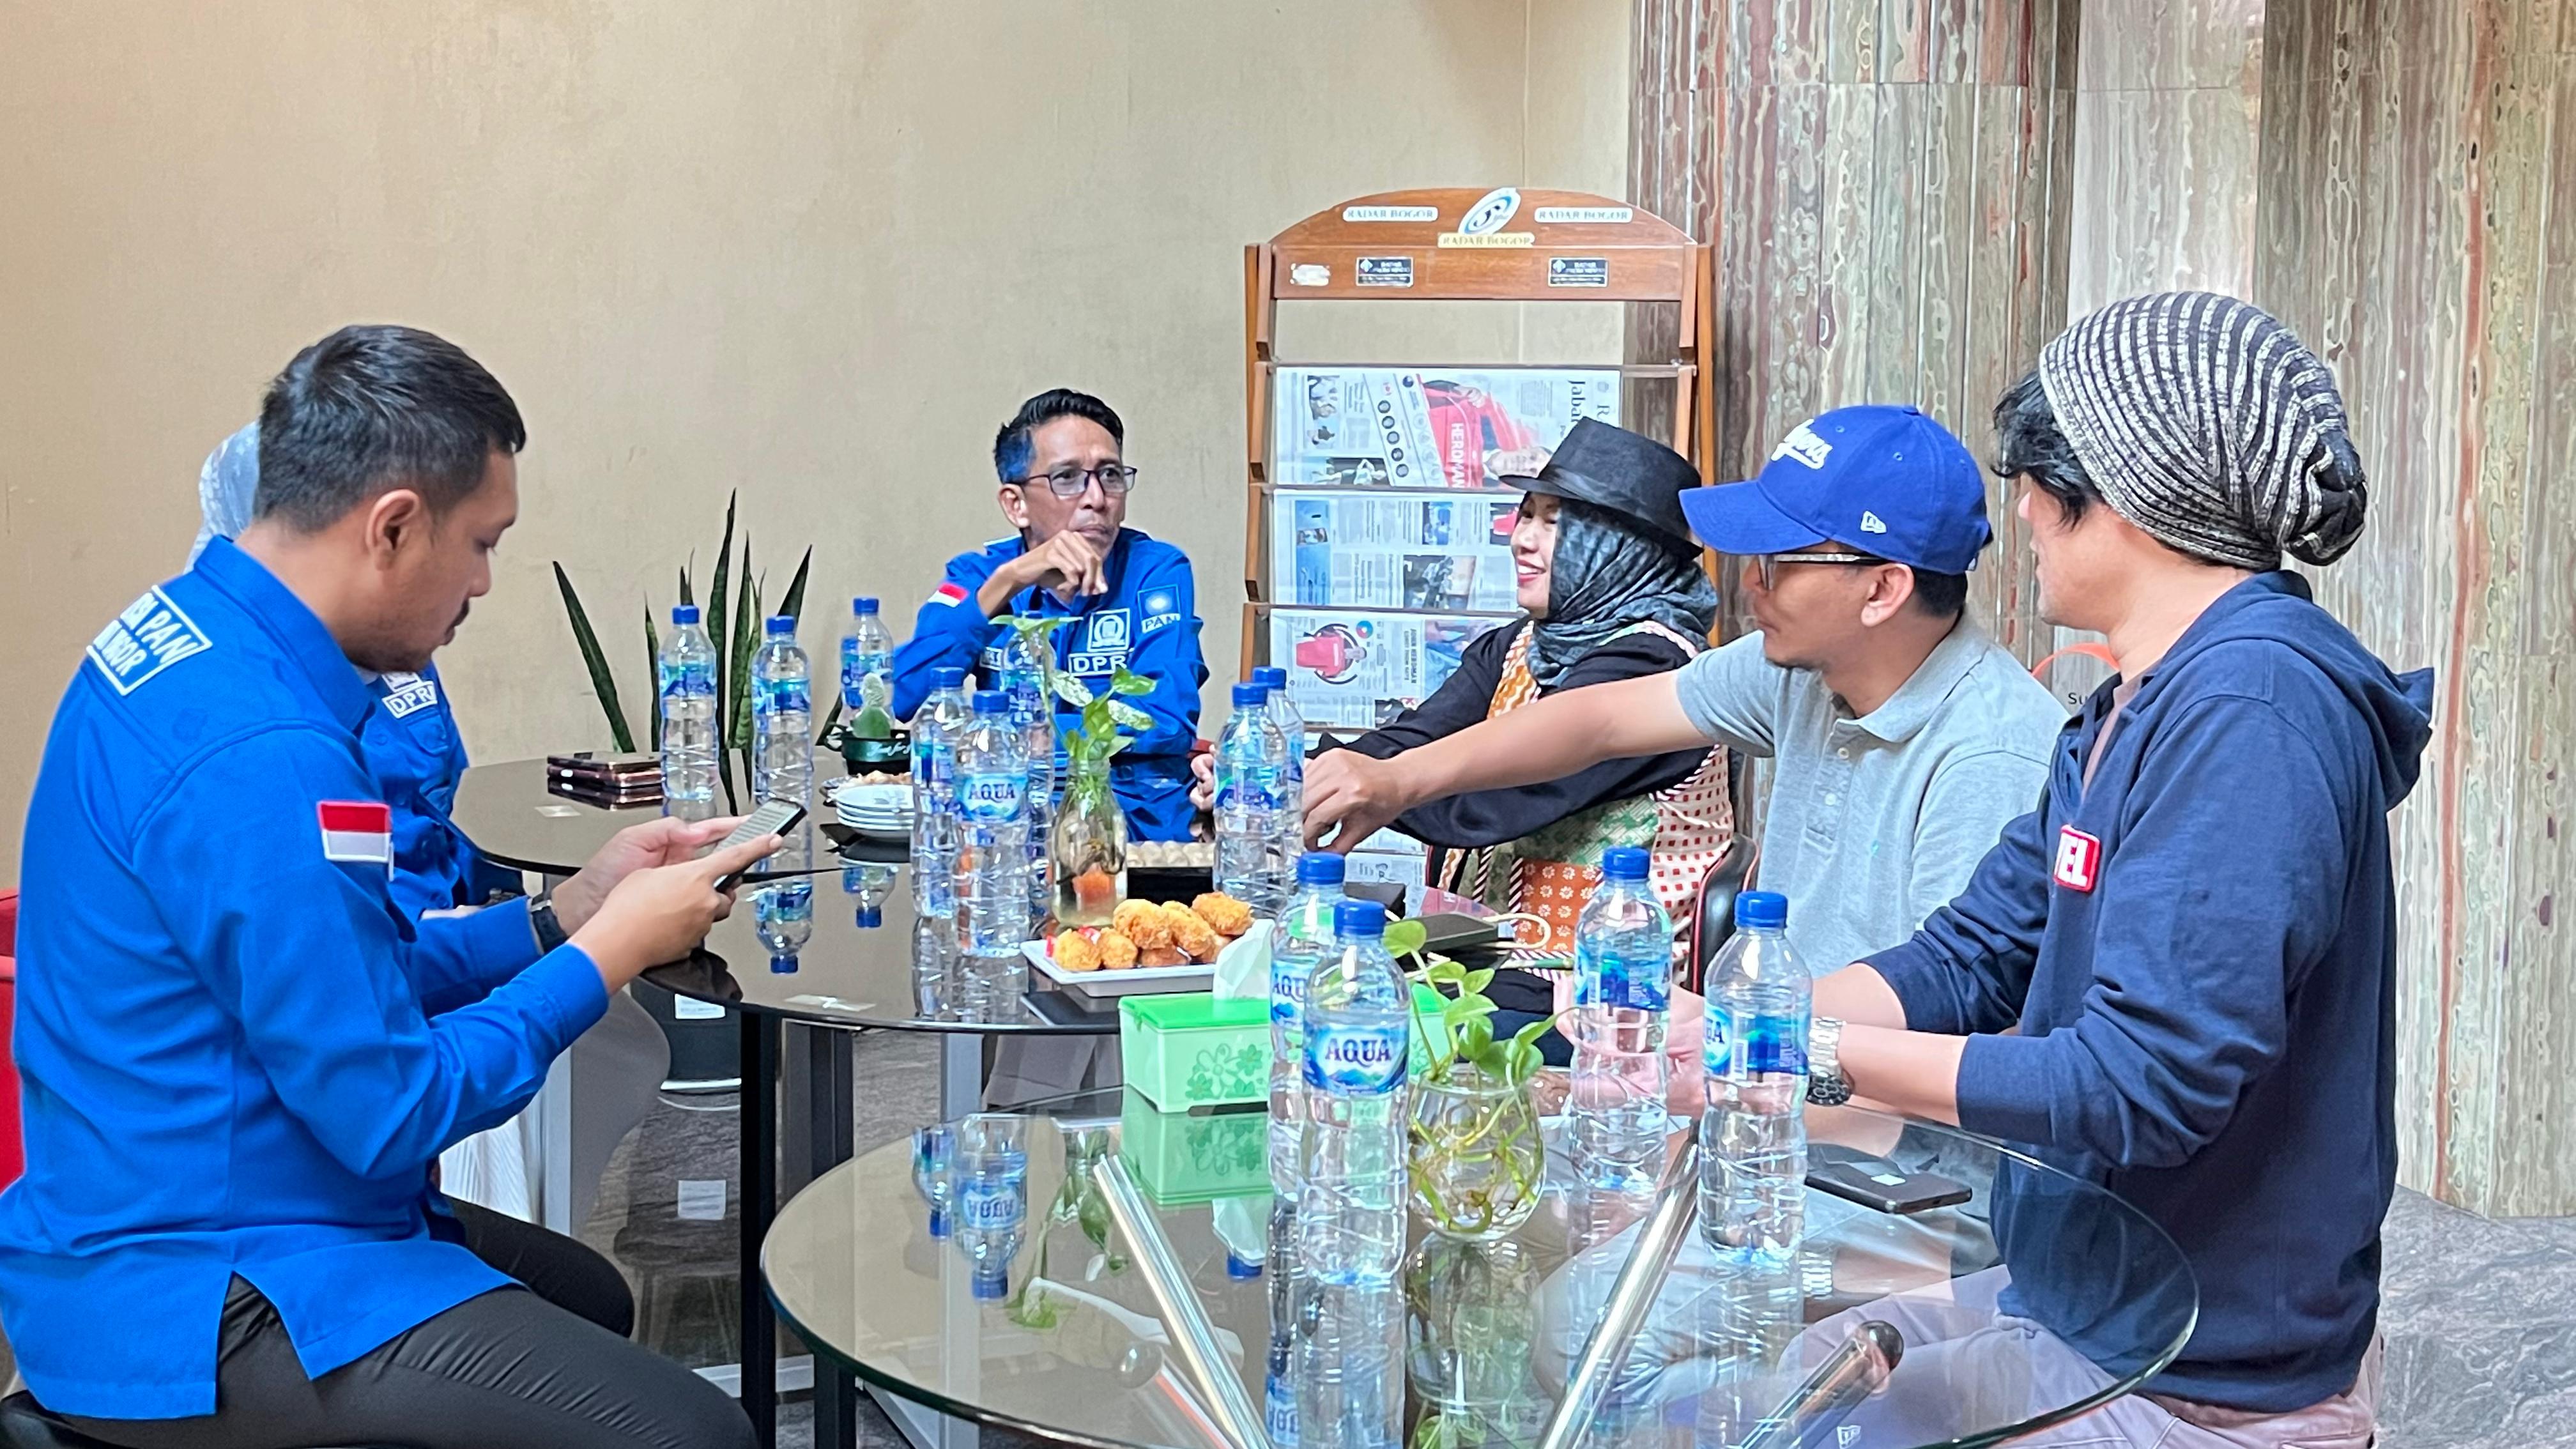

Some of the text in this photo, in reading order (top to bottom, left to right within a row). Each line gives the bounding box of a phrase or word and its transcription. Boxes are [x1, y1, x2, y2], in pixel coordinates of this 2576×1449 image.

[1347, 208, 1433, 218] RADAR BOGOR
[1538, 211, 1628, 220] RADAR BOGOR
[1443, 236, 1531, 245] RADAR BOGOR
[1450, 422, 1465, 488] HERDMAN
[134, 610, 199, 664] PAN
[968, 783, 1016, 804] AQUA
[1273, 974, 1307, 1003] AQU
[1324, 1037, 1393, 1068] AQUA
